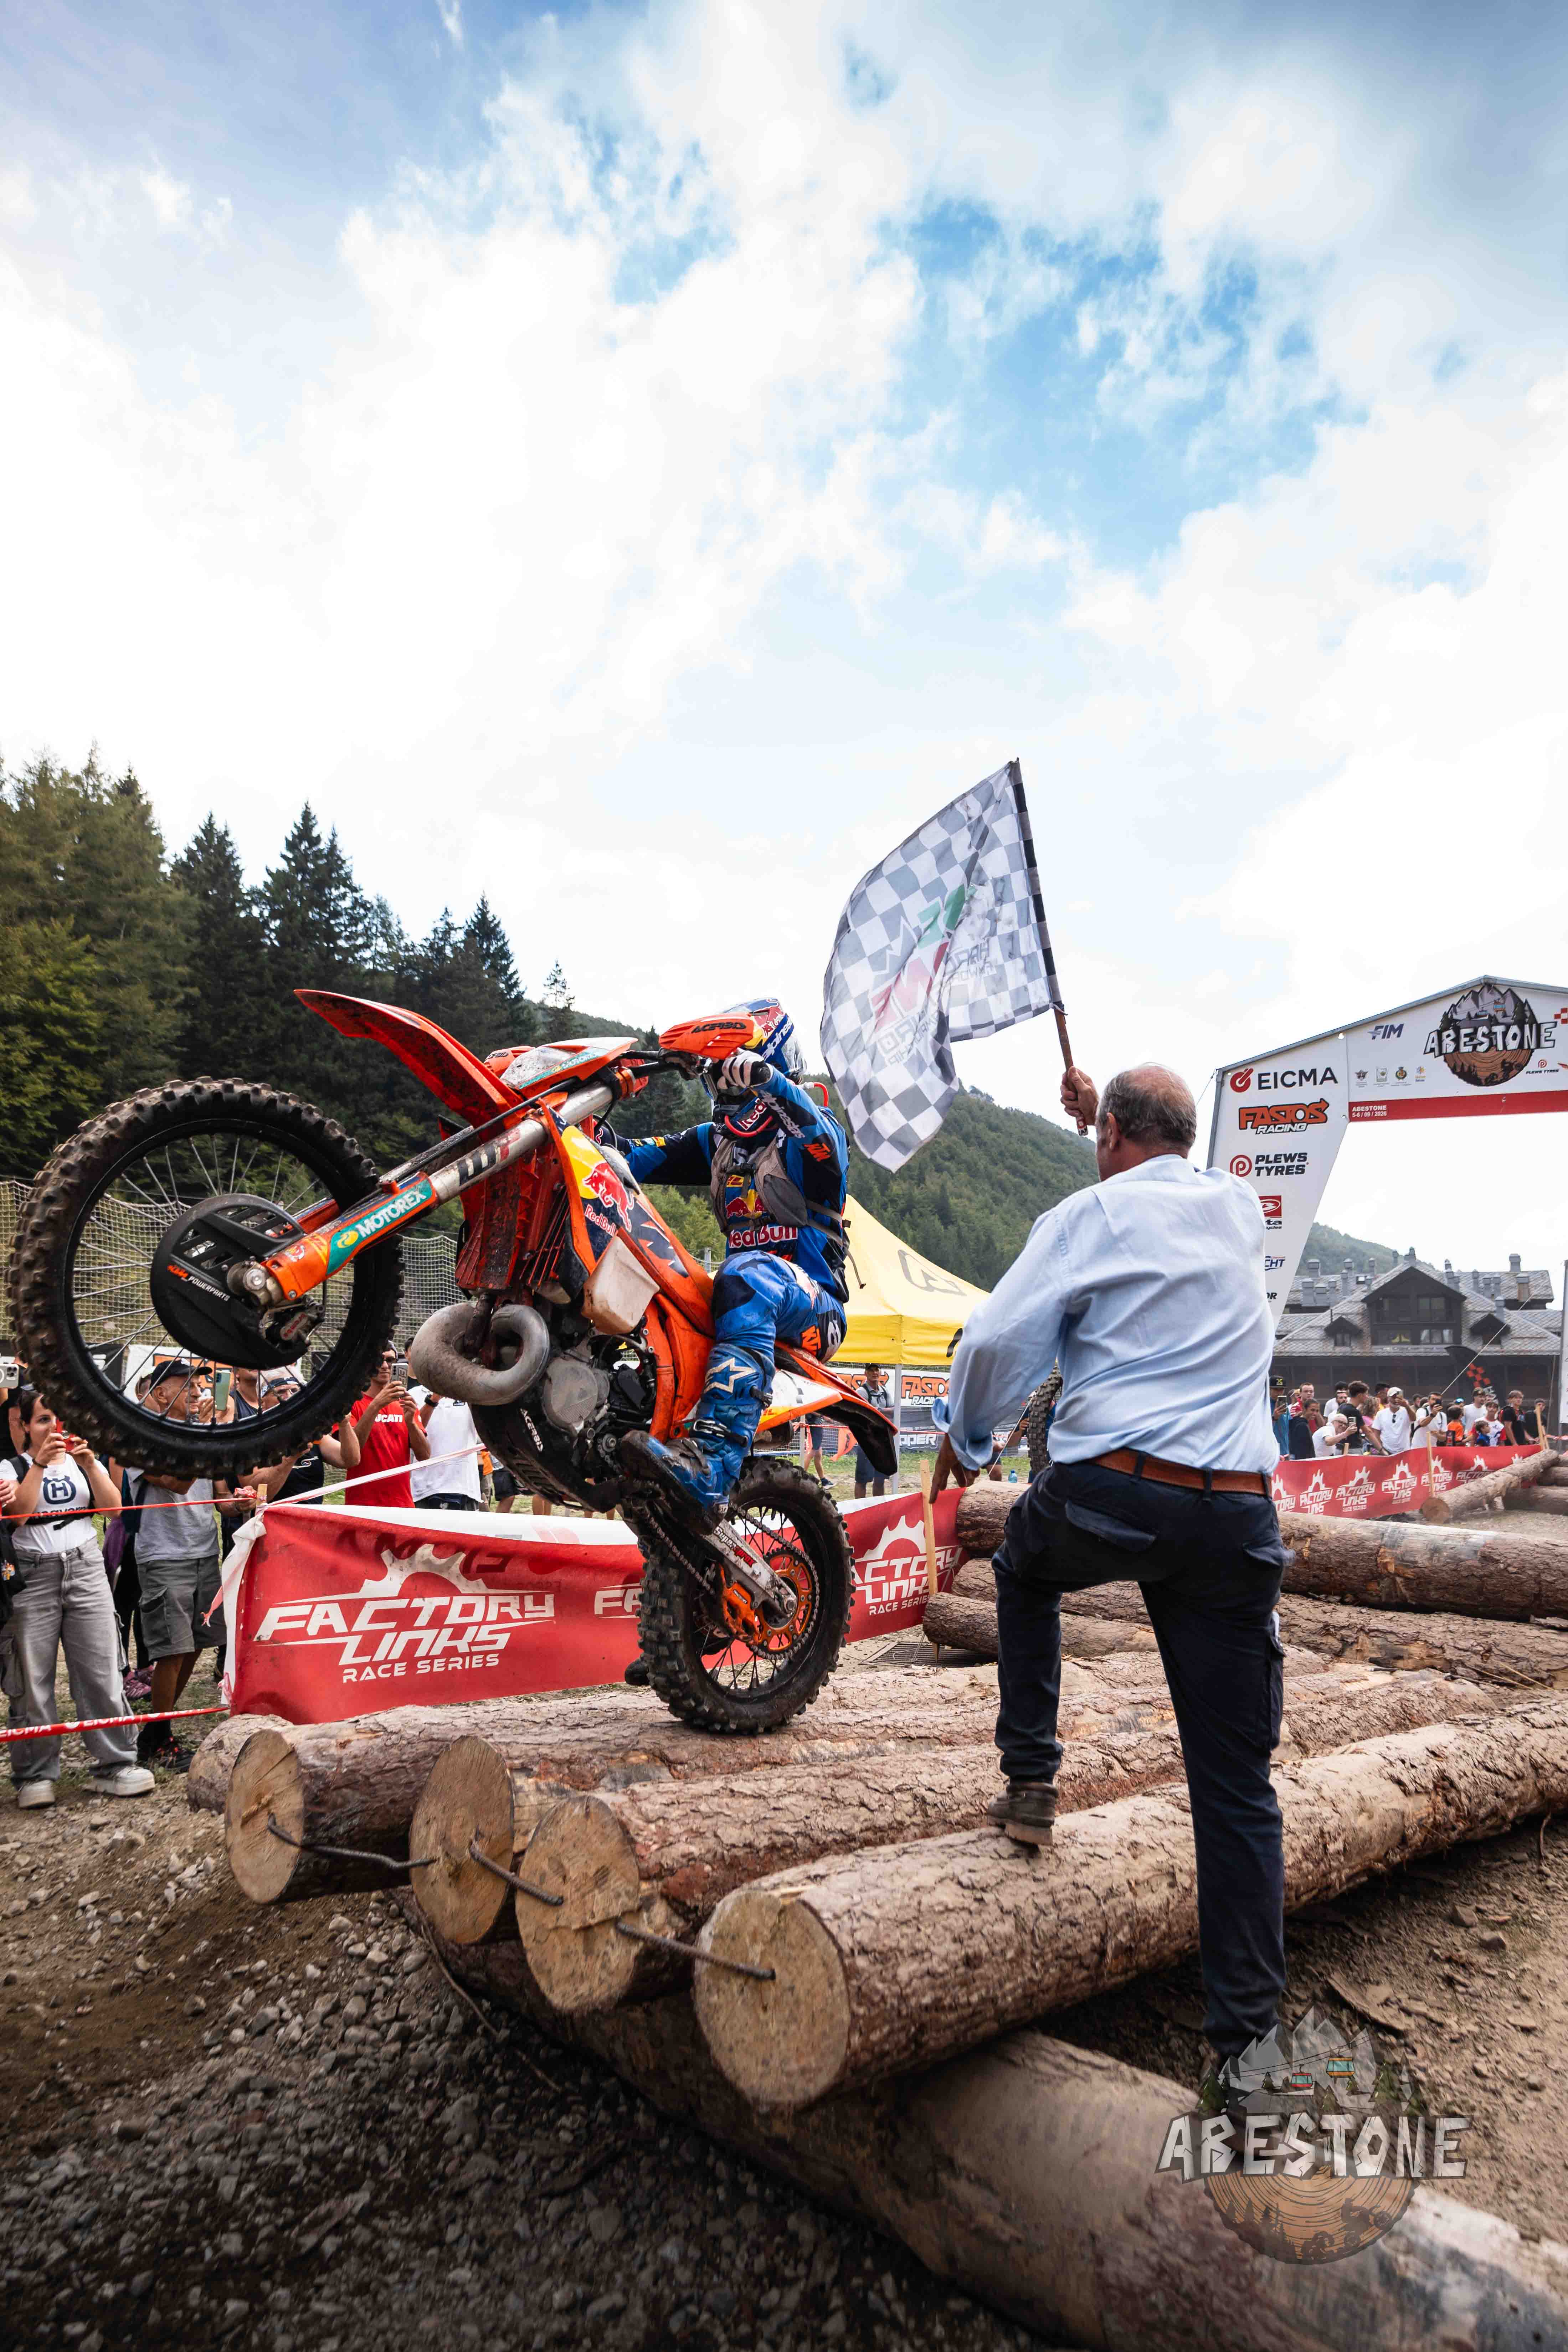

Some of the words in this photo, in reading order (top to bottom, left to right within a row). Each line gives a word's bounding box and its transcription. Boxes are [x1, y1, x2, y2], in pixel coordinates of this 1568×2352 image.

[1371, 1023, 1404, 1040] FIM
[1423, 1021, 1558, 1058] ABESTONE
[1258, 1067, 1338, 1090] EICMA
[1255, 1123, 1309, 1134] RACING
[1255, 1152, 1307, 1164] PLEWS
[1255, 1164, 1306, 1177] TYRES
[355, 1188, 427, 1238] MOTOREX
[167, 1264, 188, 1278] KTM
[188, 1276, 231, 1302] POWERPARTS
[901, 1375, 950, 1399] FASTO
[911, 1396, 935, 1405] RACI
[375, 1414, 403, 1423] UCATI
[1382, 1477, 1417, 1492] FACTORY
[1421, 1472, 1453, 1485] FATORY
[1300, 1488, 1333, 1507] FACTORY
[1336, 1482, 1376, 1499] FACTORY
[1274, 1496, 1296, 1512] TORY
[850, 1548, 962, 1584] CTORY
[869, 1602, 898, 1615] RACE
[253, 1593, 555, 1642] FACTORY
[338, 1620, 513, 1666] LINKS
[343, 1661, 406, 1684] RACE
[416, 1653, 500, 1674] SERIES
